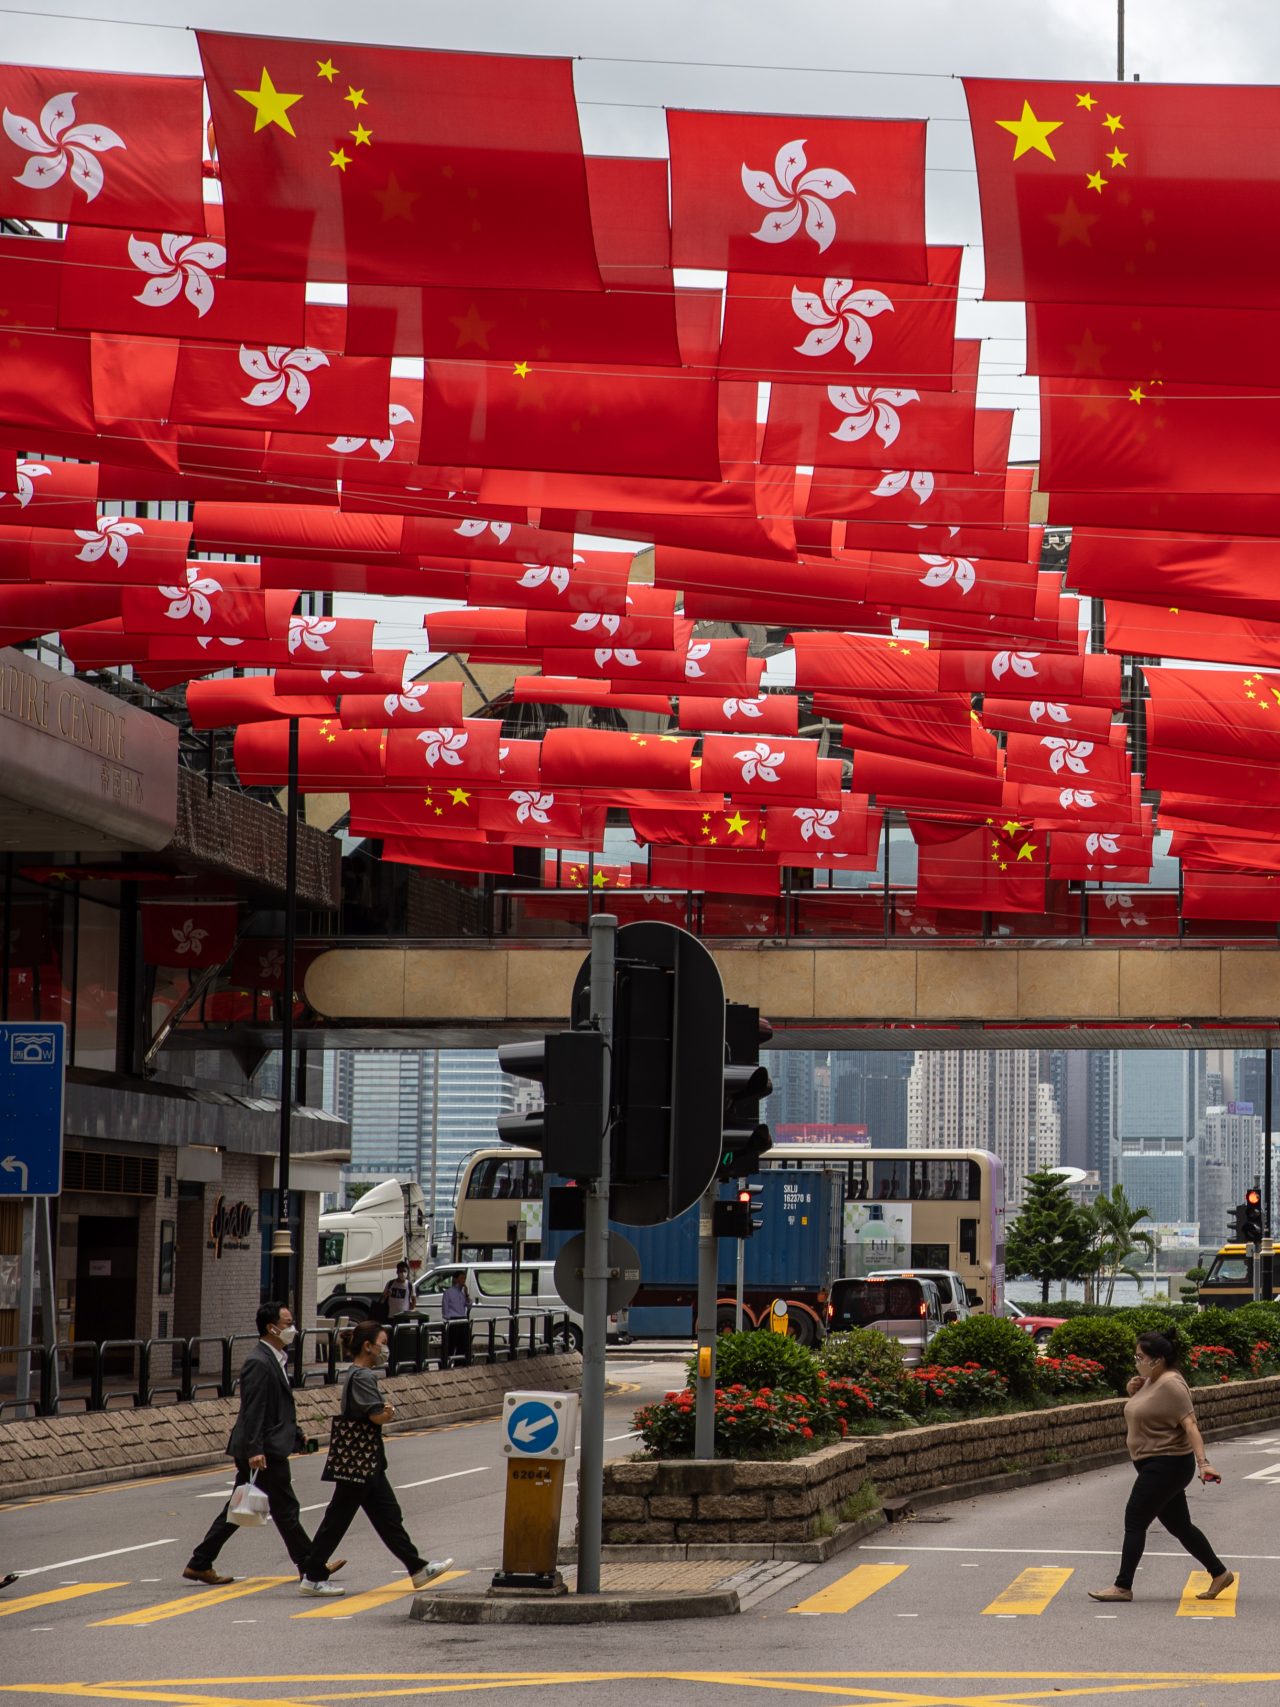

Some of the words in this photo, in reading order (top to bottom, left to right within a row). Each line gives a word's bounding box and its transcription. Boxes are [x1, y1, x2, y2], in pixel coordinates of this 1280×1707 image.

[58, 689, 126, 760] CENTRE
[42, 1050, 53, 1060] W
[784, 1184, 798, 1193] SKLU
[784, 1193, 804, 1203] 162370
